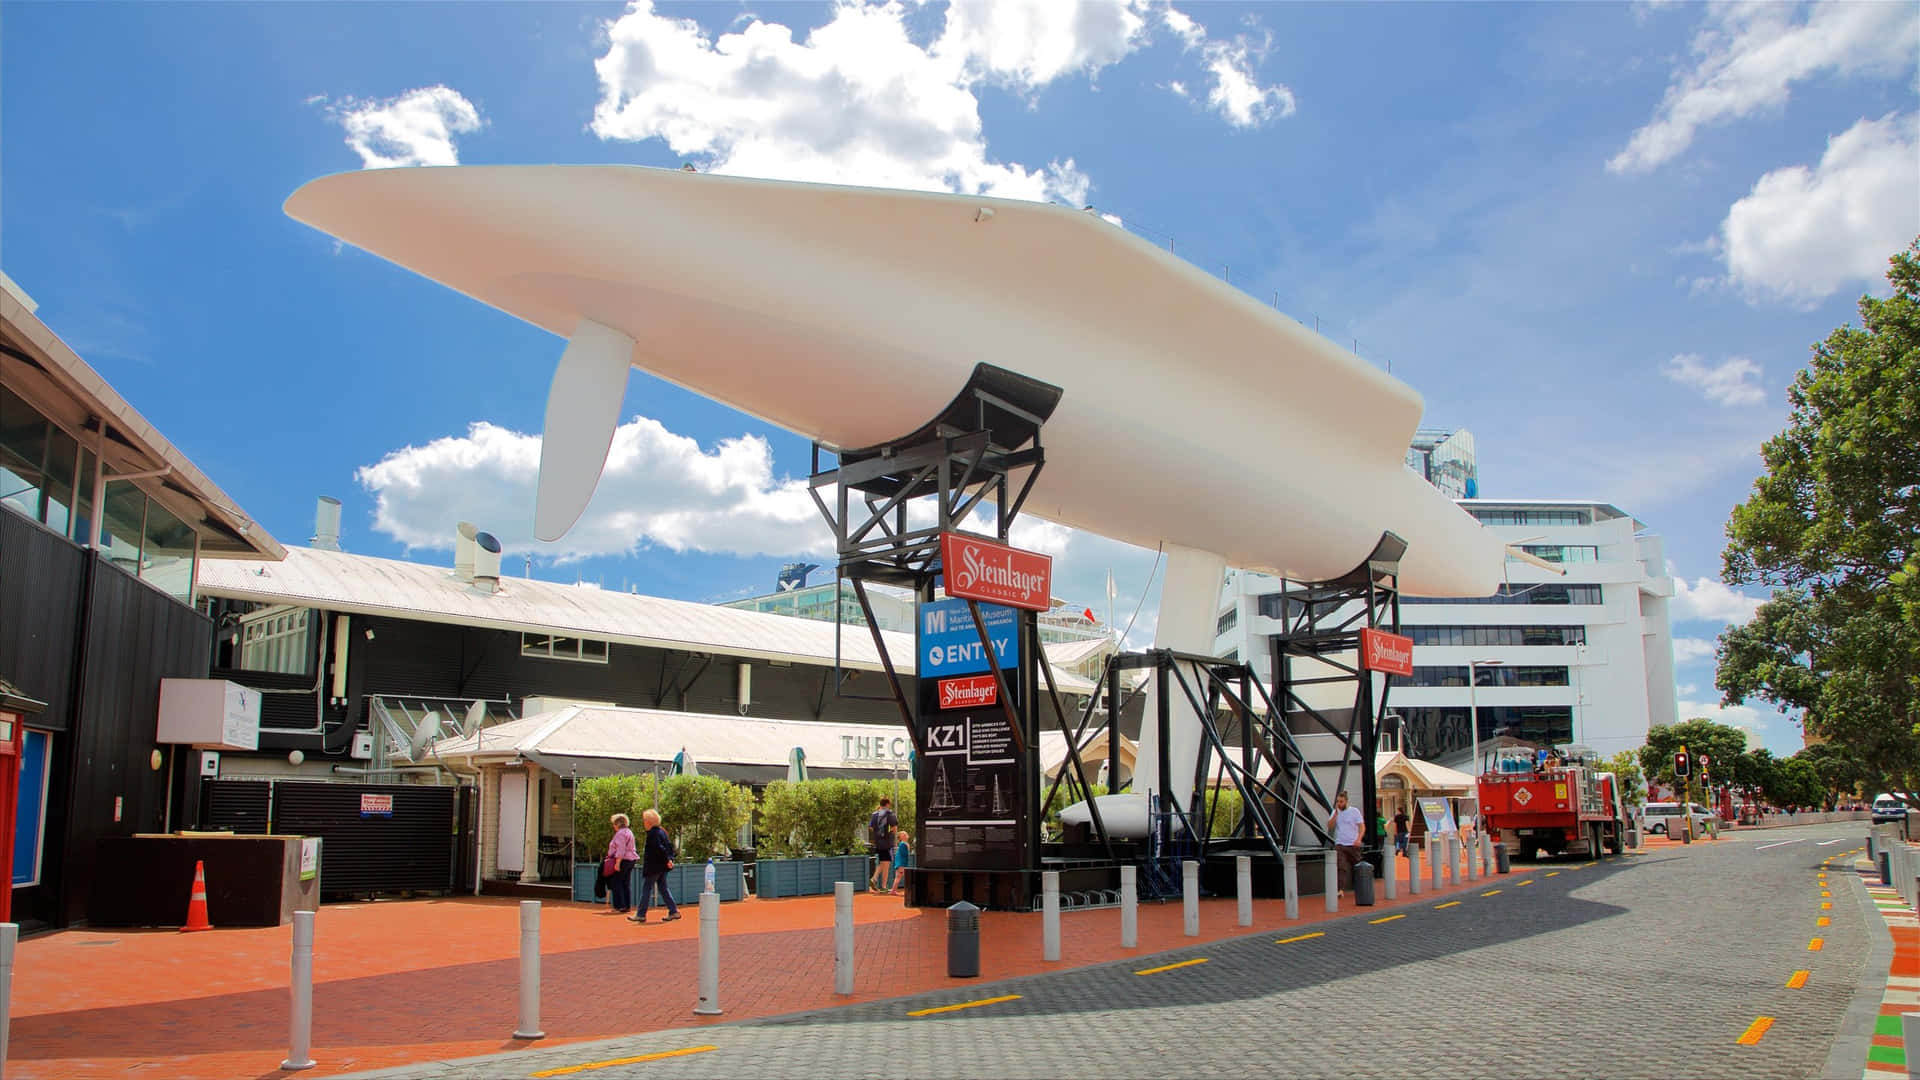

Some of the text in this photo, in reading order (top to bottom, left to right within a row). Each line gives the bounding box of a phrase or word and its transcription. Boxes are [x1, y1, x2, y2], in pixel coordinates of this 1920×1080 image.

[957, 545, 1045, 600] Steinlager
[980, 585, 1016, 597] CLASSIC
[926, 610, 945, 634] M
[1371, 636, 1410, 669] Steinlager
[942, 680, 995, 705] Steinlager
[840, 735, 885, 759] THE
[927, 724, 964, 748] KZ1
